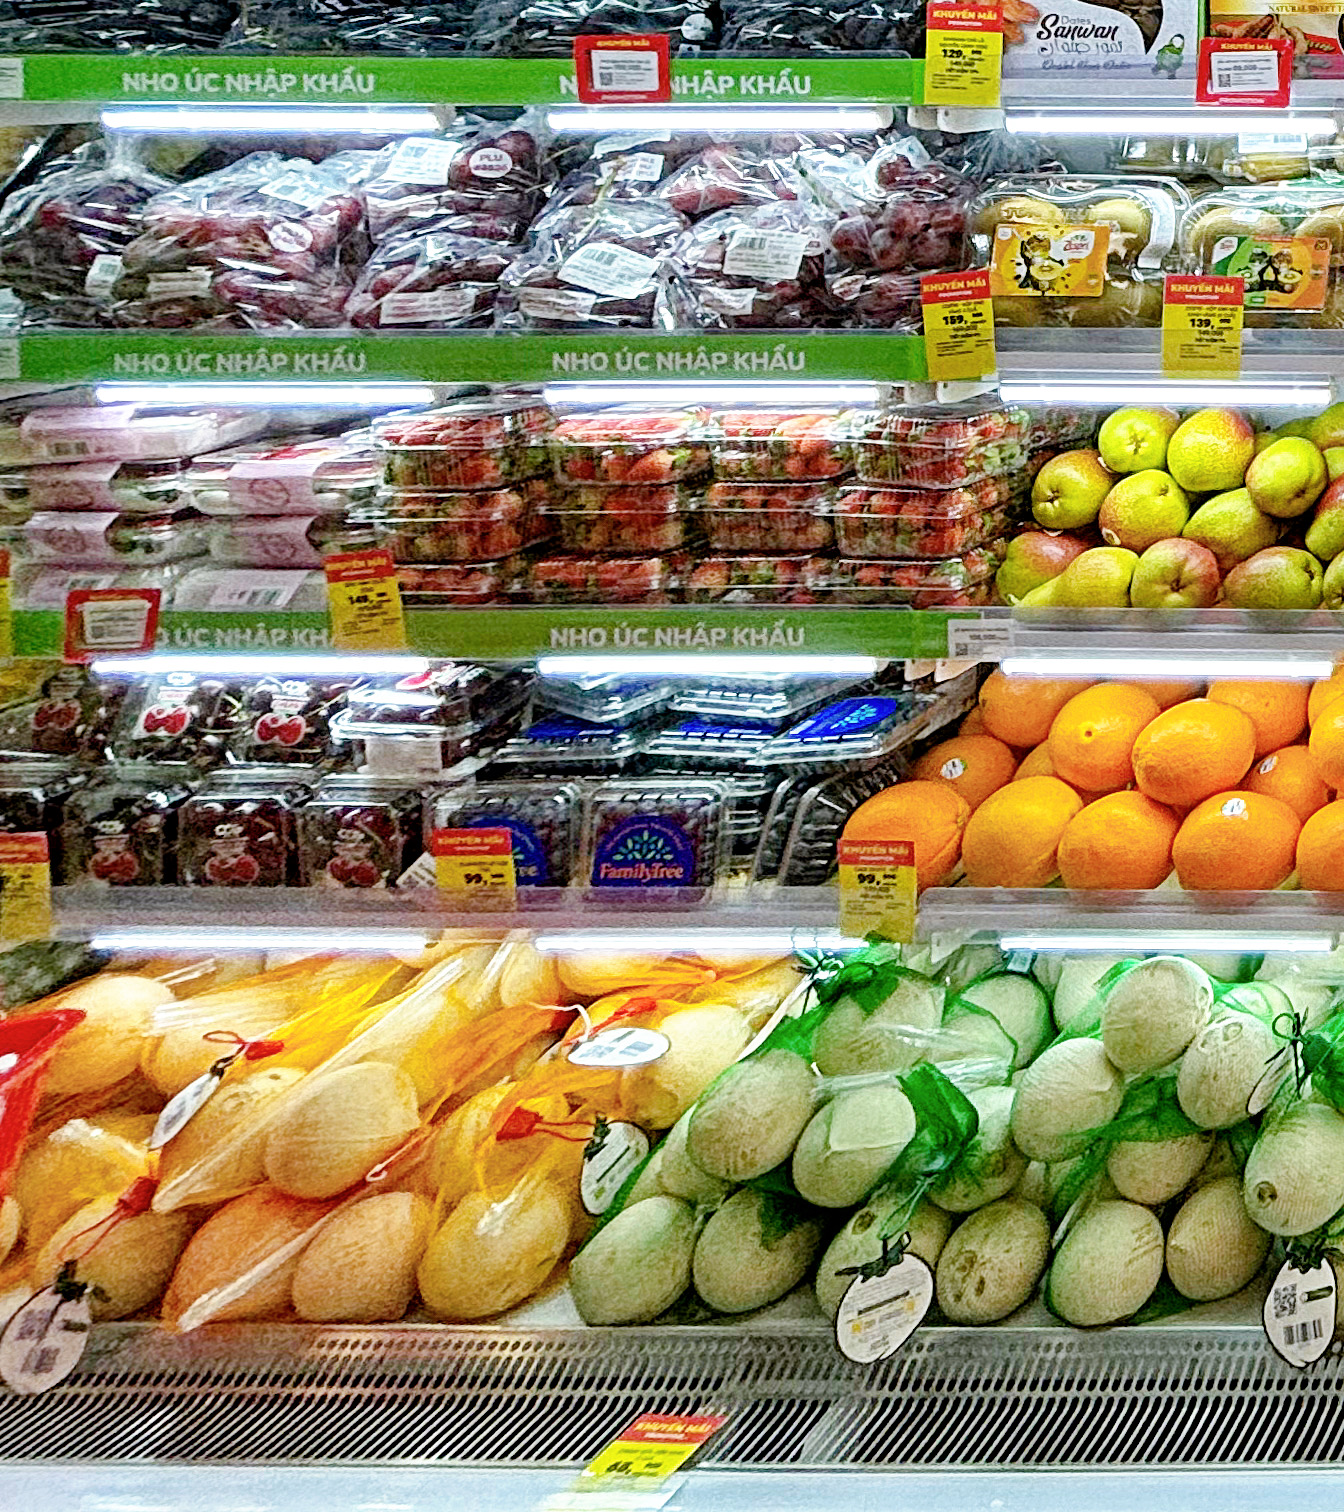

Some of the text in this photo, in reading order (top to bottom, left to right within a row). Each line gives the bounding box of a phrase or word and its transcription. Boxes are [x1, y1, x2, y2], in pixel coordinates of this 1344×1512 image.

[122, 64, 375, 96] NHO ÚC NHẬP KHẨU
[113, 343, 366, 376] NHO ÚC NHẬP KHẨU
[551, 620, 805, 651] NHO ÚC NHẬP KHẨU
